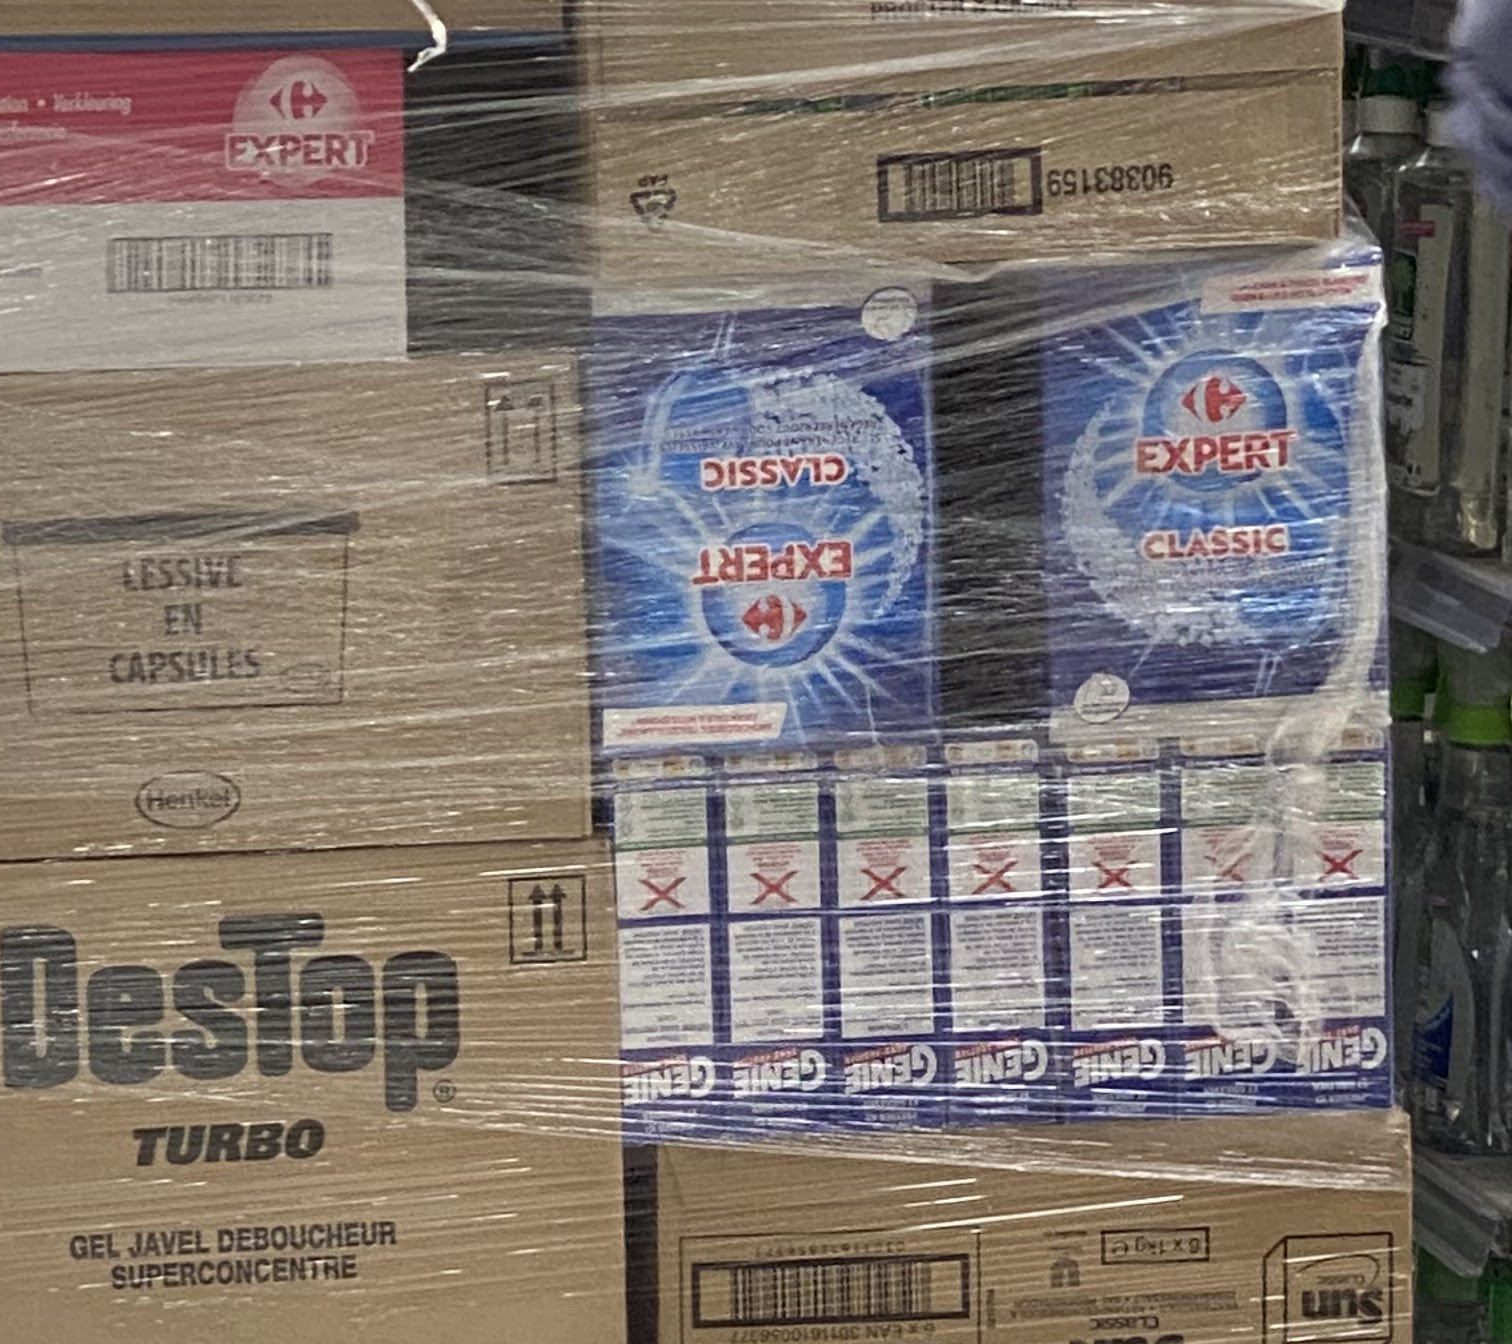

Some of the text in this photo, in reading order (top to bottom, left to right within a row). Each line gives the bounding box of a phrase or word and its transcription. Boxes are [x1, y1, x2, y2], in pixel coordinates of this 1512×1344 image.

[228, 132, 368, 169] EXPERT
[1136, 430, 1294, 474] EXPERT
[702, 455, 847, 490] CLASSIC
[693, 540, 854, 585] EXPERT
[1143, 526, 1288, 560] CLASSIC
[123, 555, 242, 594] LESSIVE
[163, 603, 204, 637] EN
[109, 650, 263, 686] CAPSULES
[144, 783, 233, 816] Henkel
[622, 1054, 716, 1105] GENIE
[731, 1048, 827, 1098] GENIE
[843, 1044, 937, 1095] GENIE
[954, 1039, 1049, 1087] GENIE
[1071, 1038, 1166, 1088] GENIE
[133, 1118, 326, 1167] TURBO
[69, 1221, 397, 1261] GEL JAVEL DEBOUCHEUR
[110, 1256, 358, 1291] SUPERCONCENTRE
